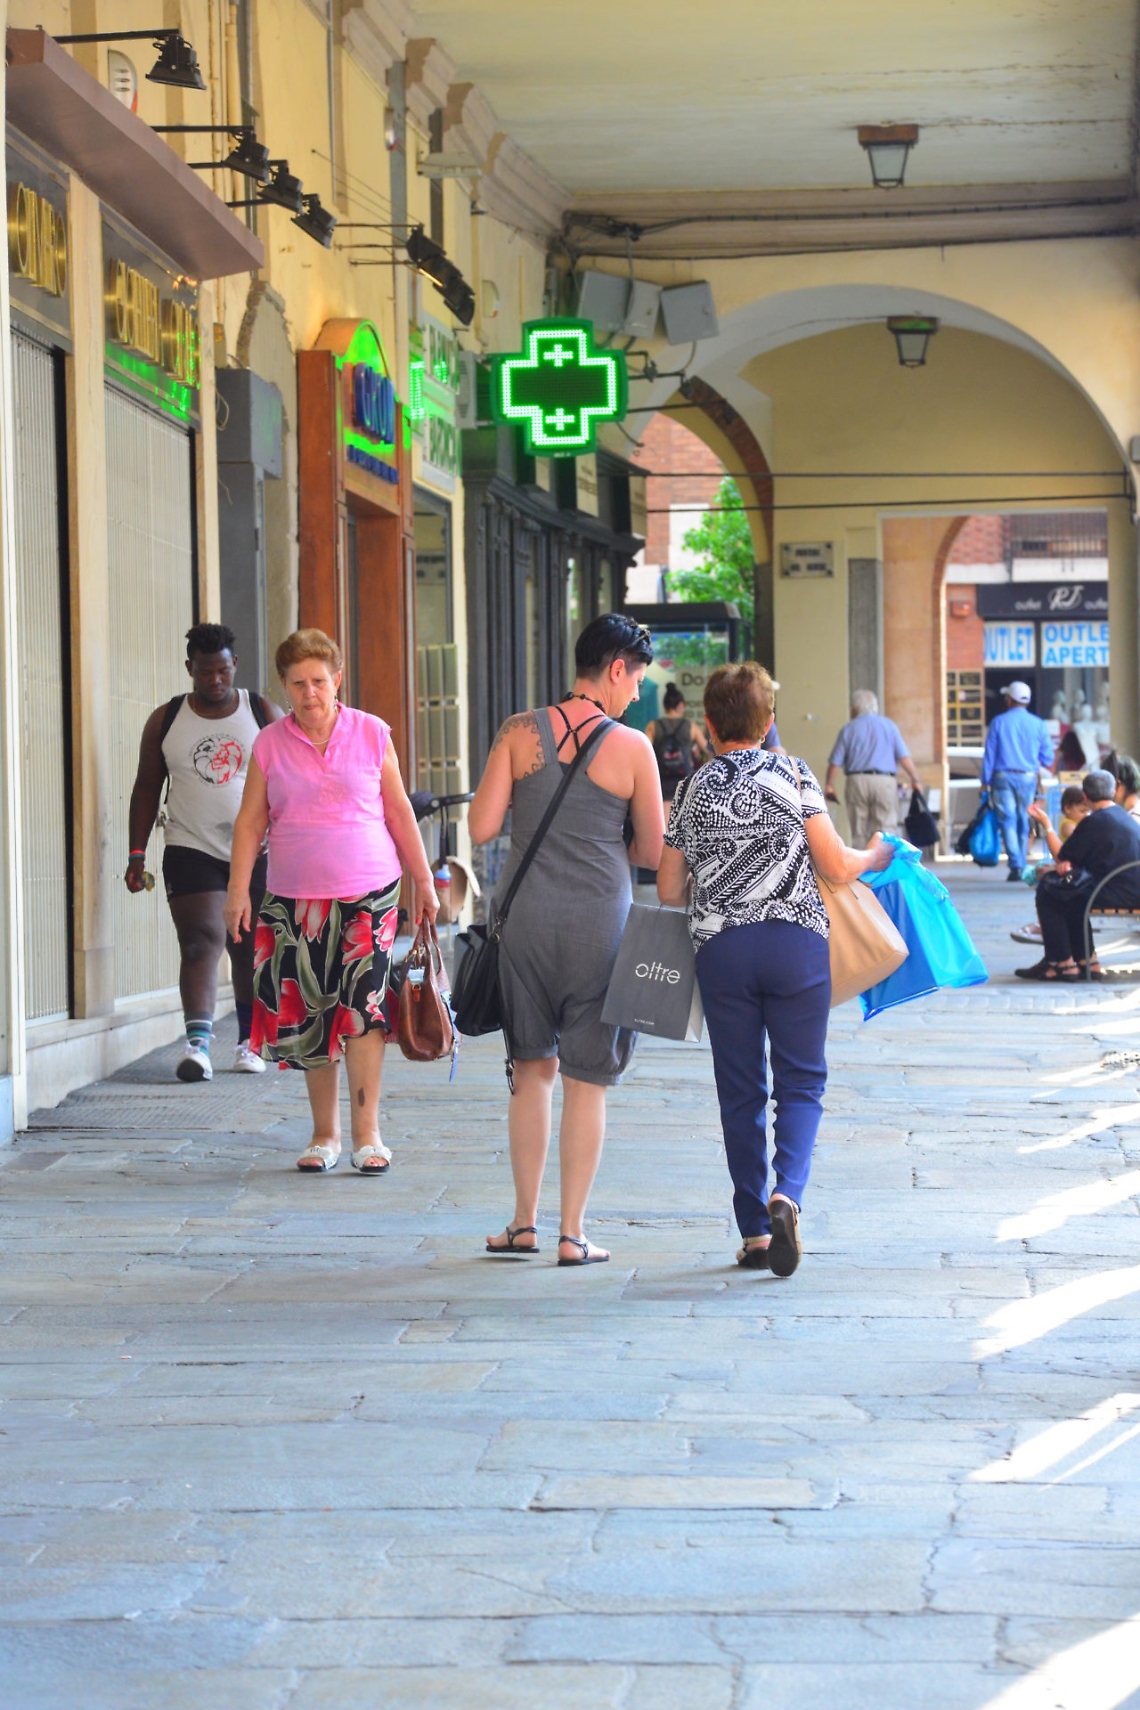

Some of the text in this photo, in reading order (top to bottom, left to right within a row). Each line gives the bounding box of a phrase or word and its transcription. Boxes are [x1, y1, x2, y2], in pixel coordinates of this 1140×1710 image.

[1014, 598, 1042, 611] outlet
[1044, 623, 1109, 642] OUTLE
[1044, 646, 1109, 665] APERT
[635, 961, 681, 984] oltre
